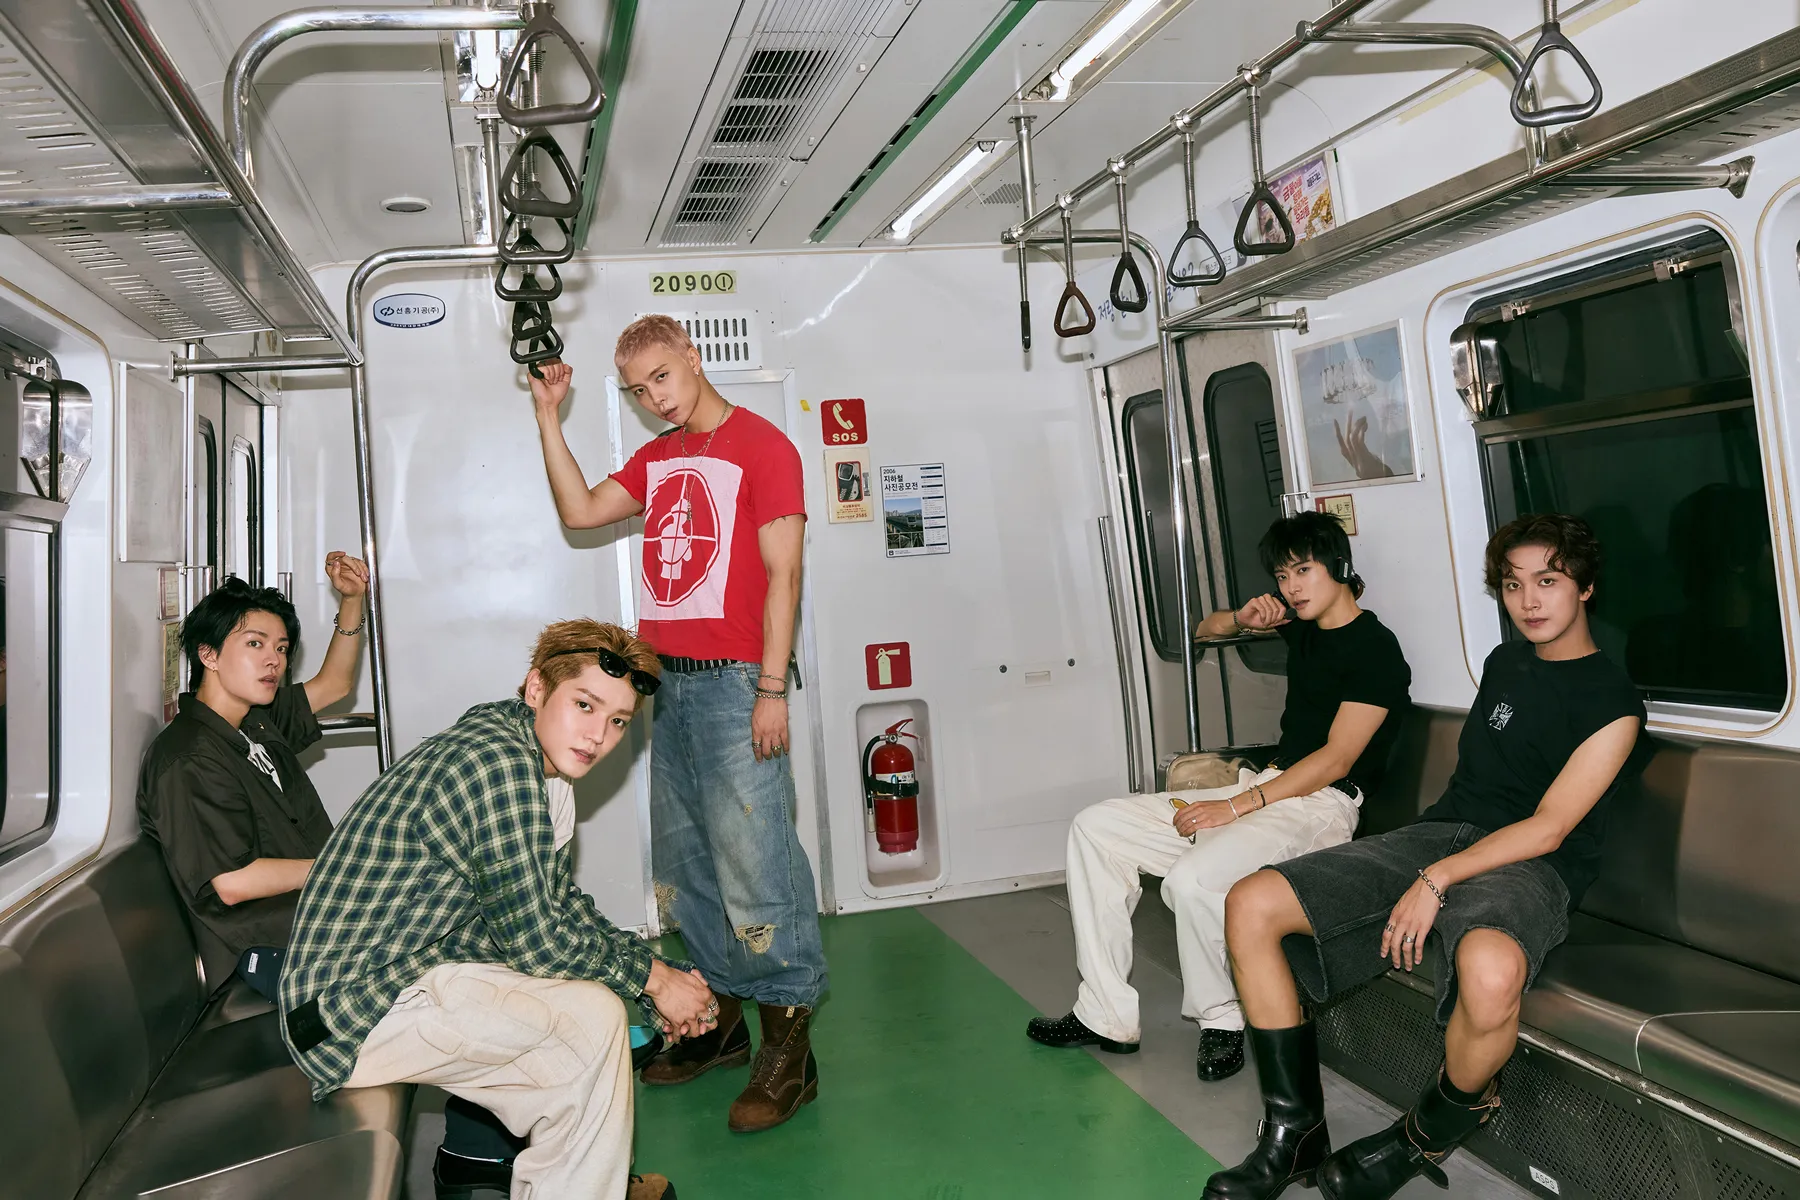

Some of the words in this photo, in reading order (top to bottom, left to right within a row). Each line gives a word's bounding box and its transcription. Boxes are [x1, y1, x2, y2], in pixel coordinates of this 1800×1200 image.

[832, 432, 858, 442] SOS
[883, 474, 904, 483] 지하철
[884, 482, 919, 492] 사진공모전
